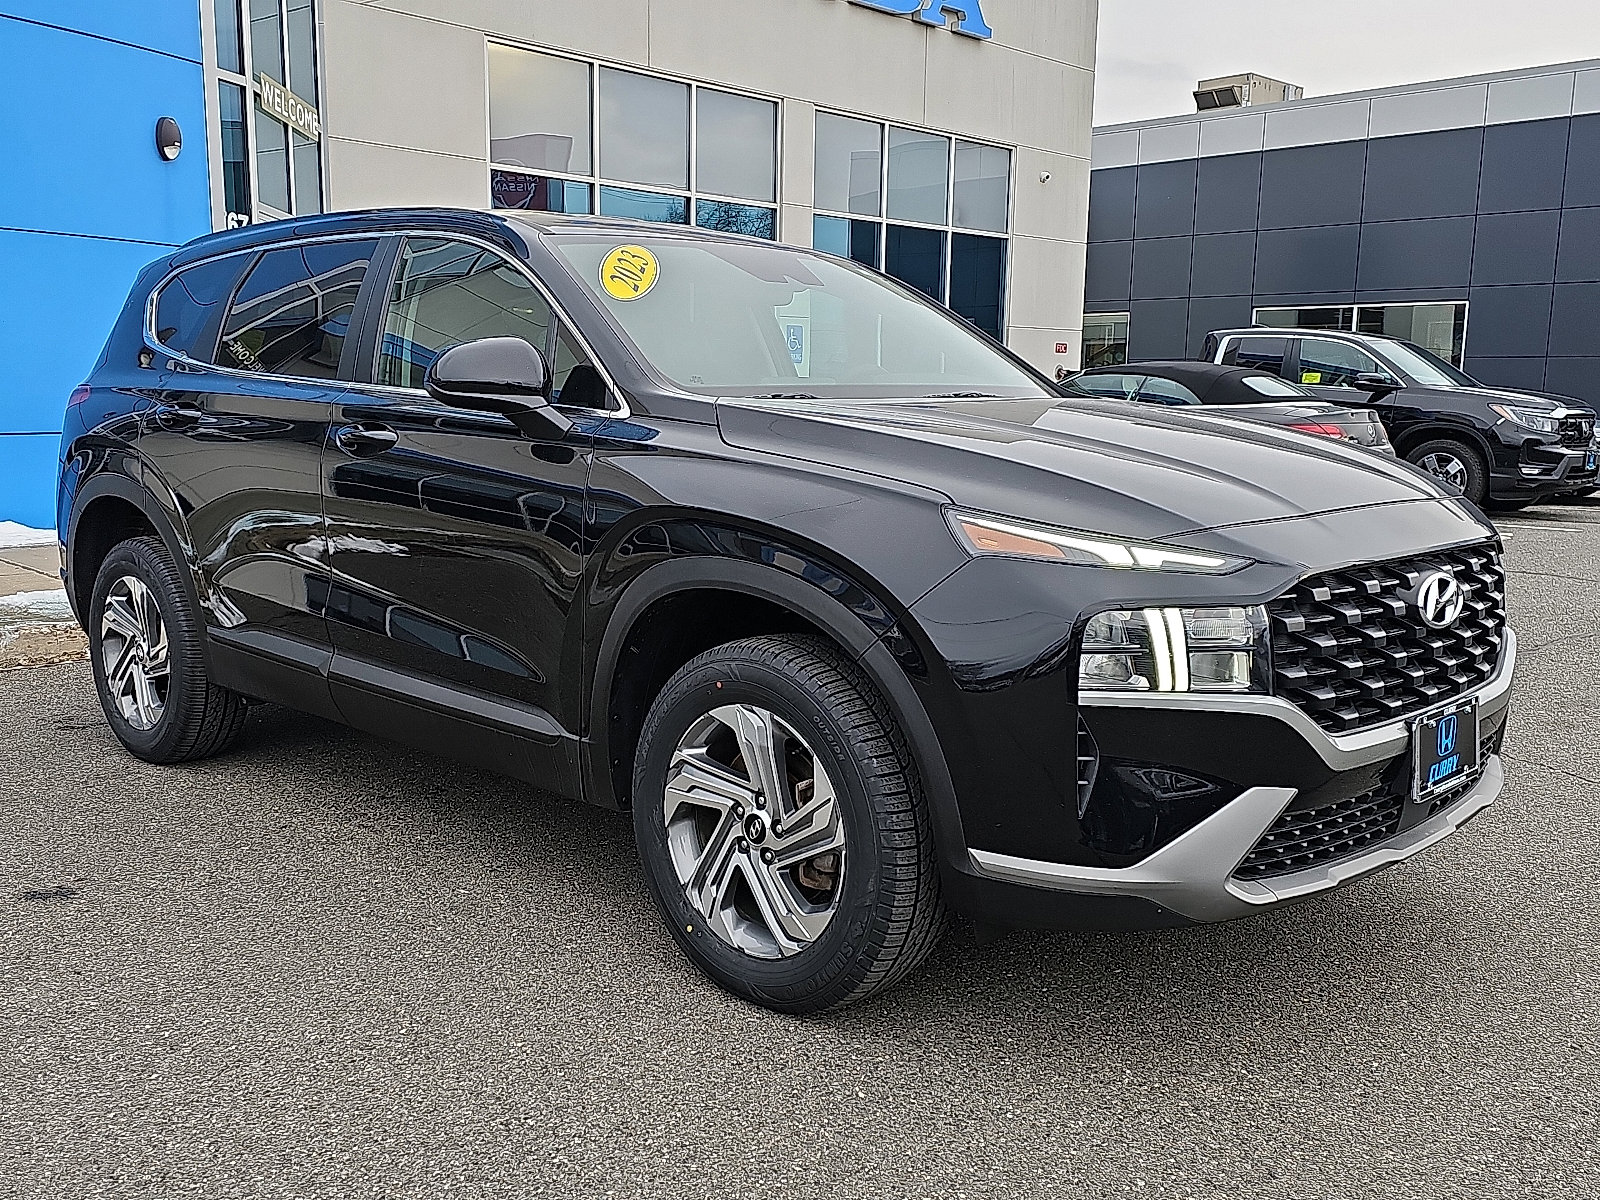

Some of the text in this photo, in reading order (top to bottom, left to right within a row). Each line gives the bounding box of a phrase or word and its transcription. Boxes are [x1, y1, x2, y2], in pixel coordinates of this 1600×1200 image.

[261, 79, 319, 136] WELCOME
[610, 250, 648, 292] 2023
[1056, 344, 1067, 353] FDC
[1429, 753, 1459, 782] CURRY
